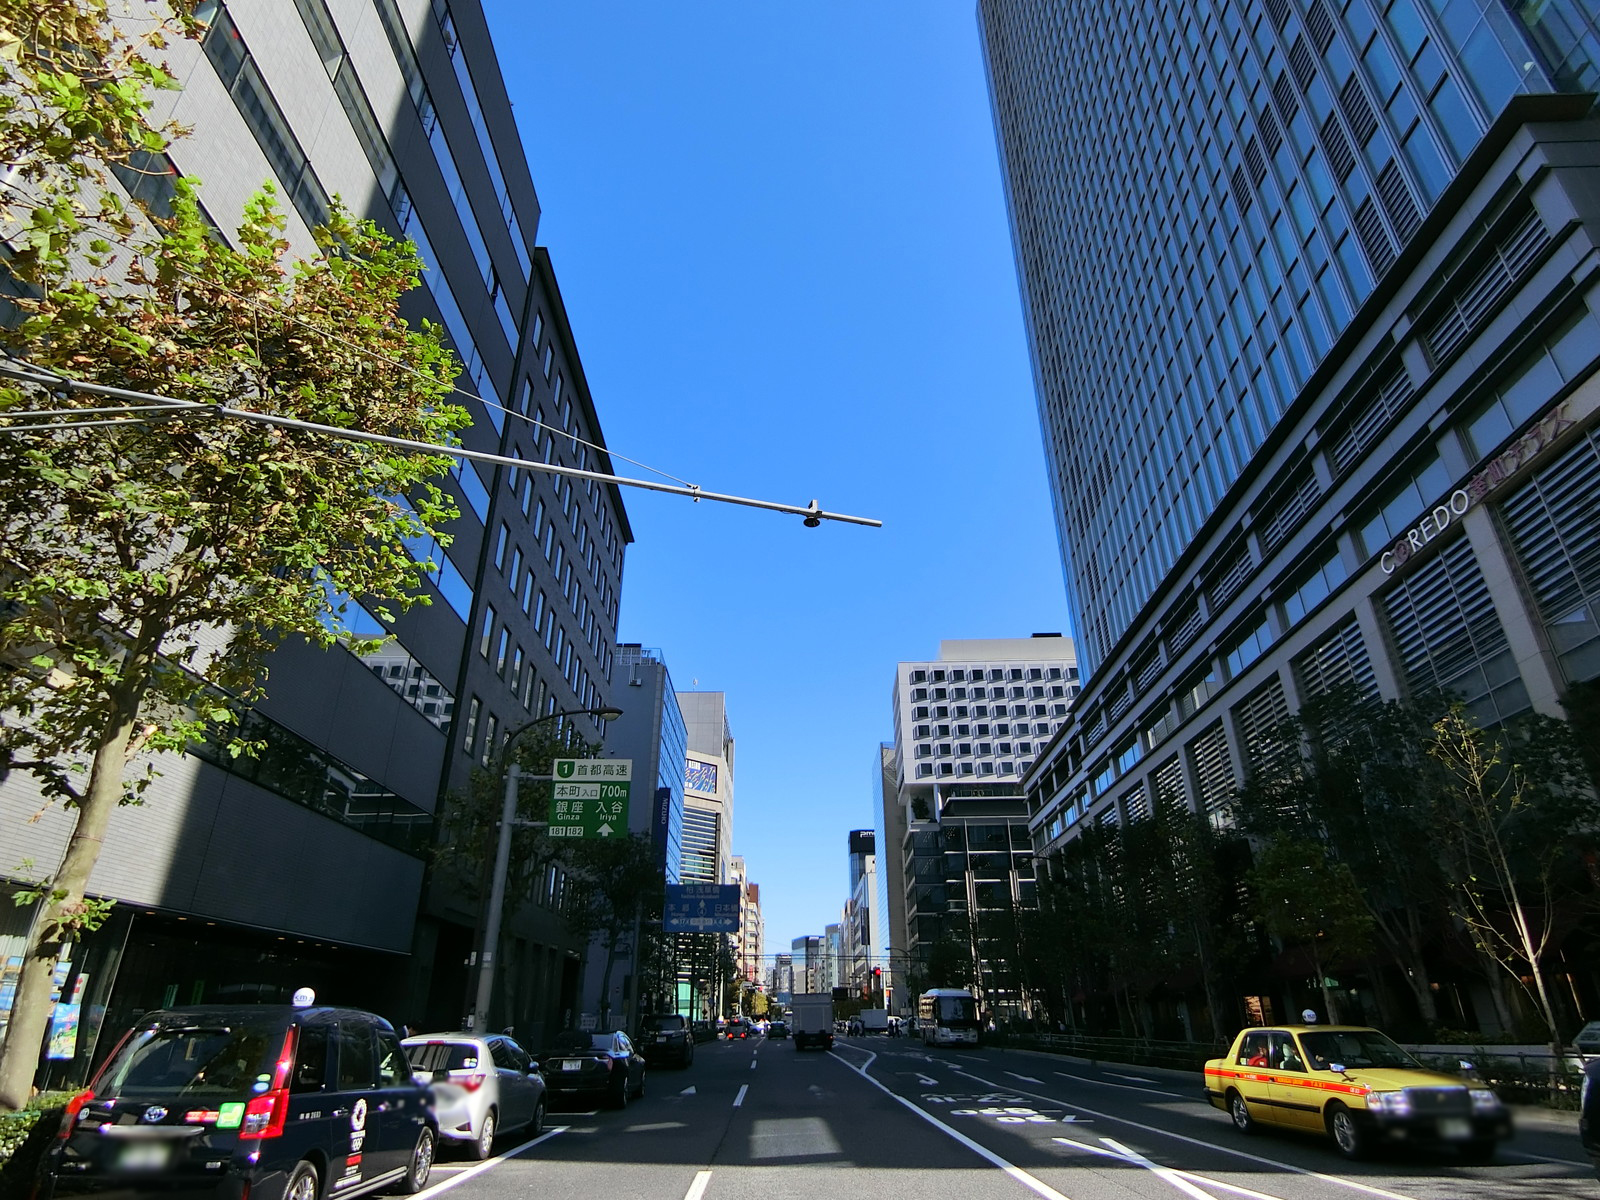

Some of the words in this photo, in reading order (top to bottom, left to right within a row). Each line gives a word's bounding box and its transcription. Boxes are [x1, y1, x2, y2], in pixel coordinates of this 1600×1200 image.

[1380, 489, 1469, 574] COREDO
[577, 764, 628, 776] 首都高速
[602, 785, 627, 798] 700m
[556, 801, 584, 813] 銀座
[595, 801, 623, 813] 入谷
[599, 813, 617, 822] Iriya
[551, 827, 564, 835] 181
[568, 827, 583, 835] 182
